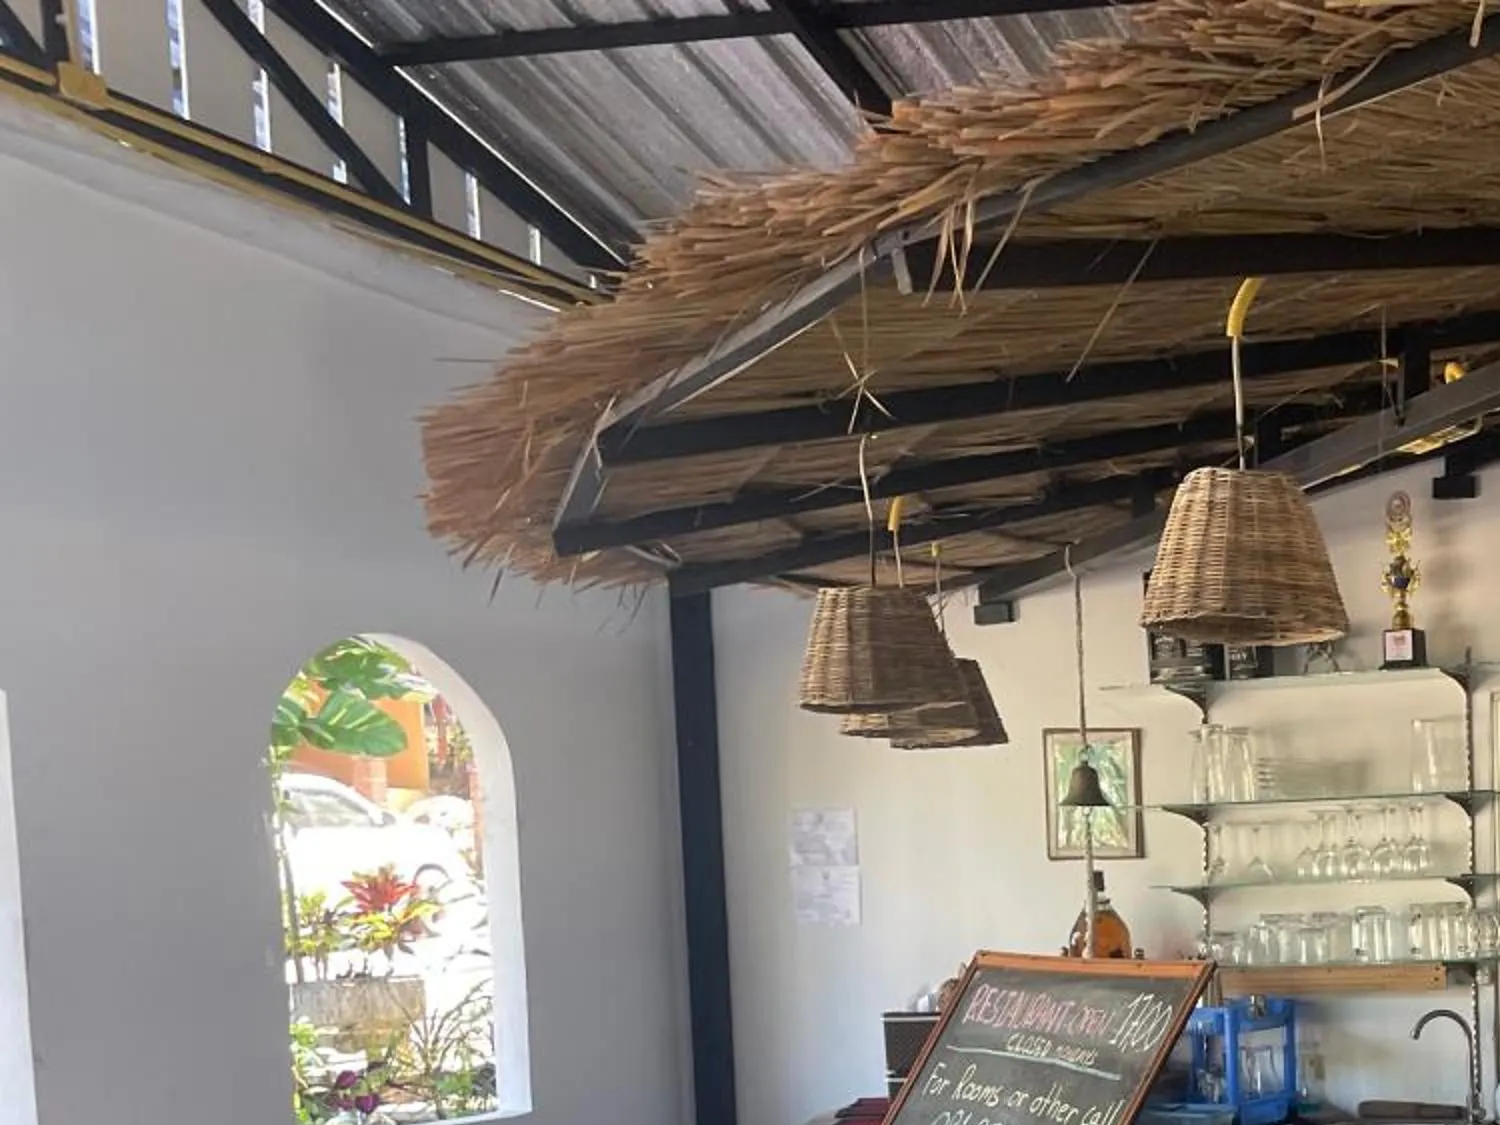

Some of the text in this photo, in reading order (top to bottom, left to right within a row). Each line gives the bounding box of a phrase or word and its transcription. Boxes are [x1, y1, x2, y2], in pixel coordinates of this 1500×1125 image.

[923, 1062, 949, 1096] For
[952, 1063, 1004, 1107] Rooms
[1008, 1090, 1029, 1107] or
[1030, 1081, 1079, 1125] other
